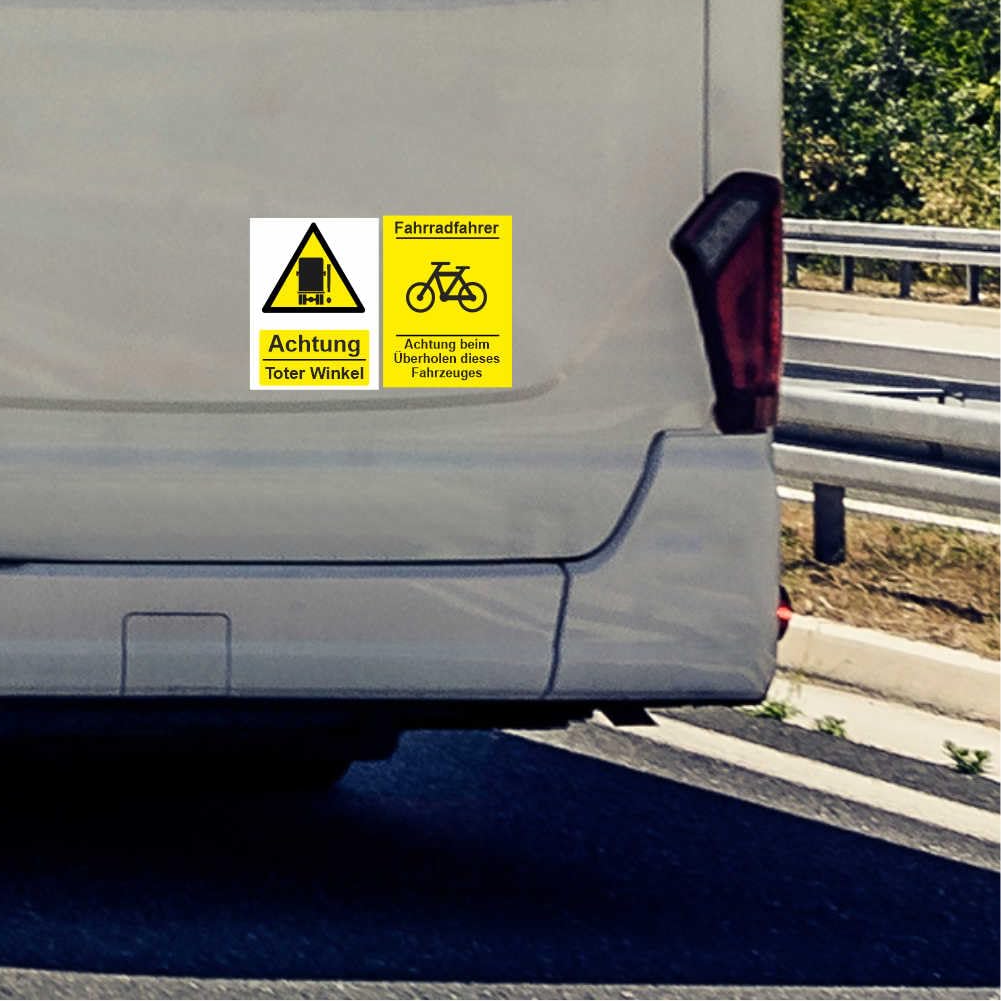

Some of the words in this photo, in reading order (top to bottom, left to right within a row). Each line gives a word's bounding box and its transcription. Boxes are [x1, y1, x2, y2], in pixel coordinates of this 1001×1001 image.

[394, 221, 500, 234] Fahrradfahrer
[269, 334, 361, 357] Achtung
[404, 338, 455, 351] Achtung
[460, 338, 490, 350] beim
[394, 350, 457, 364] Überholen
[461, 352, 500, 364] dieses
[265, 366, 306, 380] Toter
[309, 366, 364, 380] Winkel
[411, 366, 483, 380] Fahrzeuges
